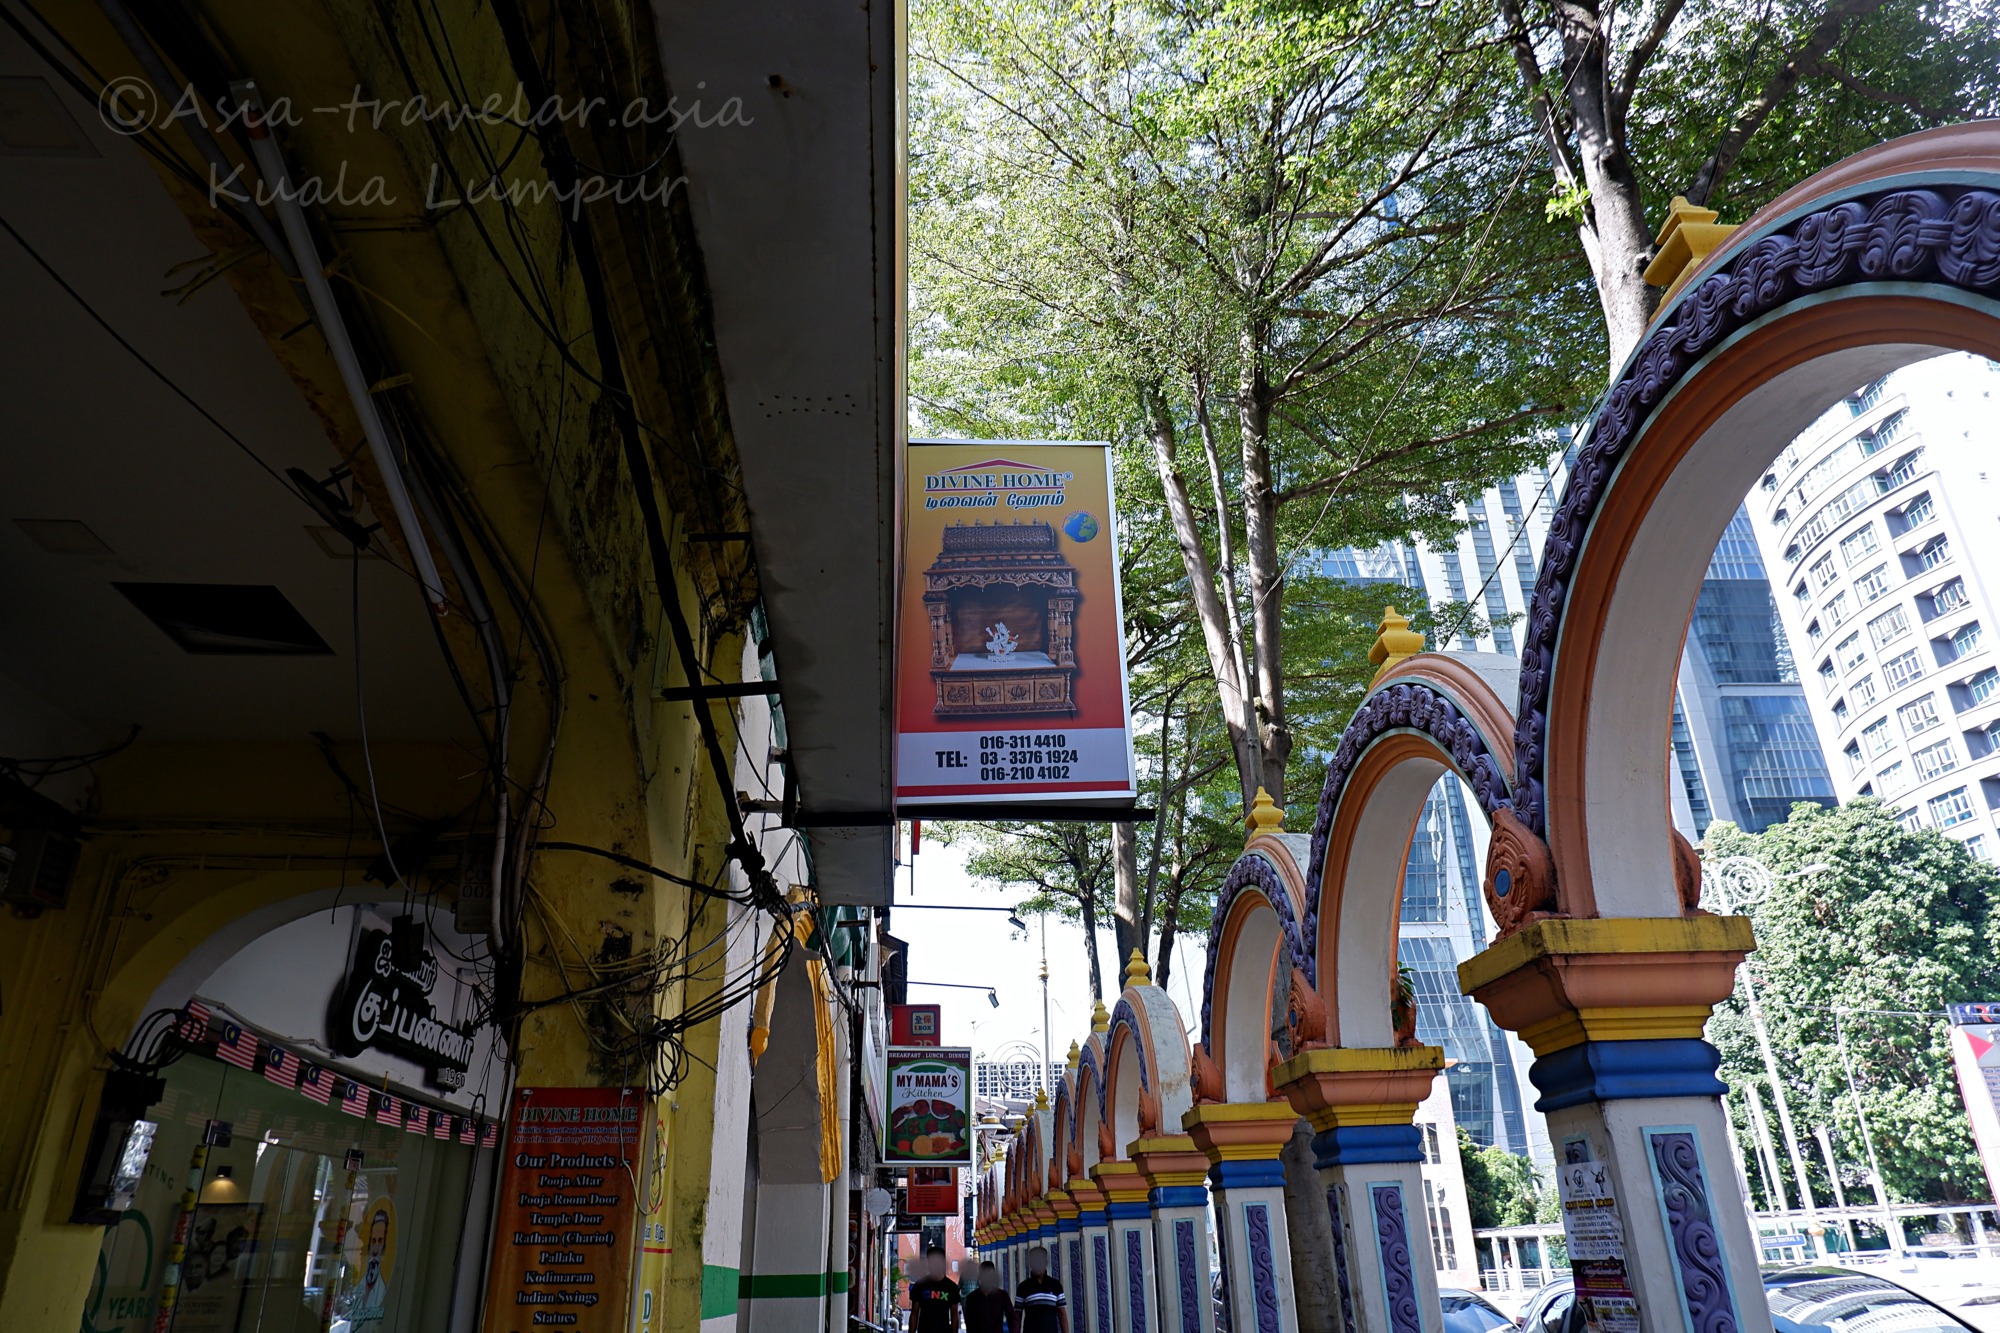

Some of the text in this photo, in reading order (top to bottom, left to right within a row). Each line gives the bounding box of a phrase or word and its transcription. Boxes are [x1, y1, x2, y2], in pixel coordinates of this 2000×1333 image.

[926, 474, 996, 489] DIVINE
[980, 734, 1066, 749] 016-311 4410
[935, 751, 968, 768] TEL:
[980, 752, 998, 765] 03
[1009, 751, 1043, 764] 3376
[1046, 750, 1078, 763] 1924
[981, 766, 1069, 780] 016-210 4102
[445, 1069, 465, 1087] 1960
[896, 1074, 958, 1088] MY MAMA'S
[902, 1087, 943, 1098] Kitchen
[518, 1107, 637, 1122] DIVINE HOME
[515, 1154, 547, 1167] Our
[550, 1153, 615, 1168] Products
[539, 1175, 602, 1189] Pooja Altar
[520, 1194, 618, 1207] Pooja Room Door
[531, 1213, 603, 1227] Temple Door
[513, 1232, 614, 1246] Ratham (Chariot)
[540, 1252, 584, 1264] Pallaku
[525, 1271, 594, 1284] Kodimaram
[517, 1291, 598, 1305] Indian Swings
[108, 1297, 151, 1320] YEARS
[533, 1312, 576, 1324] Statues
